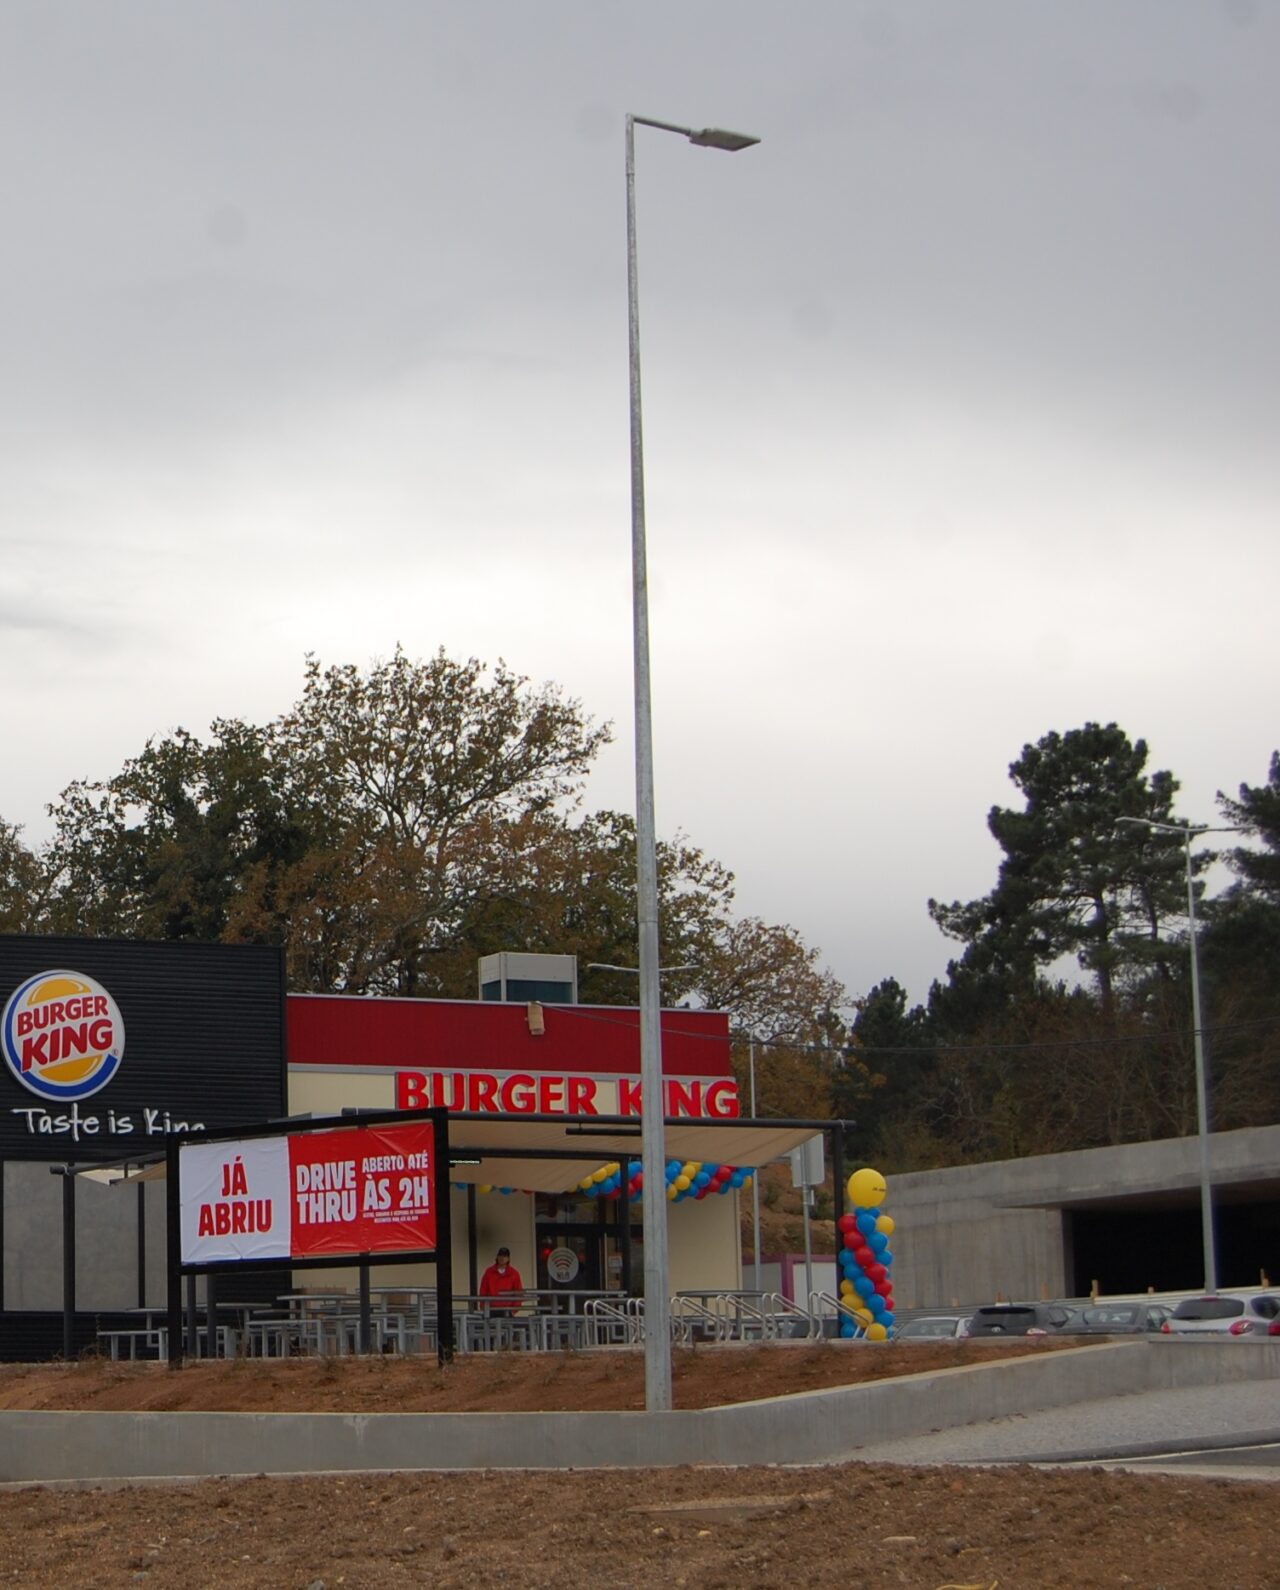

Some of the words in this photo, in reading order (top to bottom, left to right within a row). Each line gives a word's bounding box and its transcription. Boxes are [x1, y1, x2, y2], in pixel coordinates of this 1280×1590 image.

[17, 995, 109, 1037] BURGER
[20, 1019, 113, 1073] KING
[396, 1071, 597, 1115] BURGER
[618, 1077, 741, 1119] KNG
[10, 1102, 100, 1142] Taste
[107, 1110, 134, 1134] is
[222, 1156, 248, 1197] JÁ
[296, 1160, 357, 1193] DRIVE
[362, 1155, 405, 1173] ABERTO
[408, 1149, 429, 1170] ATÉ
[297, 1190, 358, 1225] THRU
[363, 1174, 392, 1211] ÀS
[399, 1176, 429, 1209] 2H
[198, 1199, 273, 1237] ABRIU
